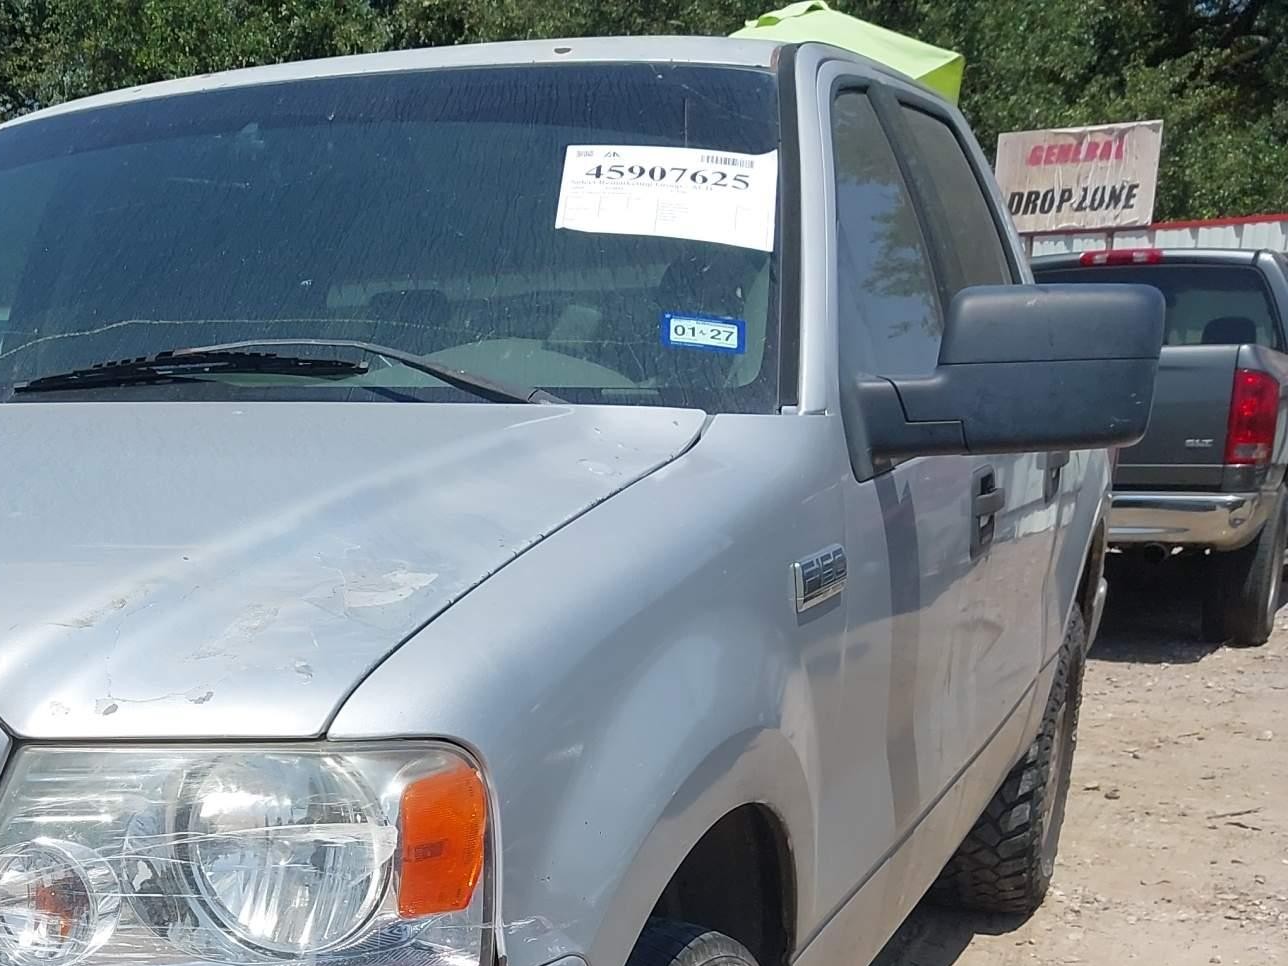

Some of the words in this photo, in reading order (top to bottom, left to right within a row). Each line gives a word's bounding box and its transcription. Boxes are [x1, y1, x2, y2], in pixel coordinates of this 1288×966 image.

[584, 164, 751, 191] 45907625
[1006, 187, 1073, 216] DROP
[673, 324, 696, 338] 01
[709, 328, 734, 342] 27
